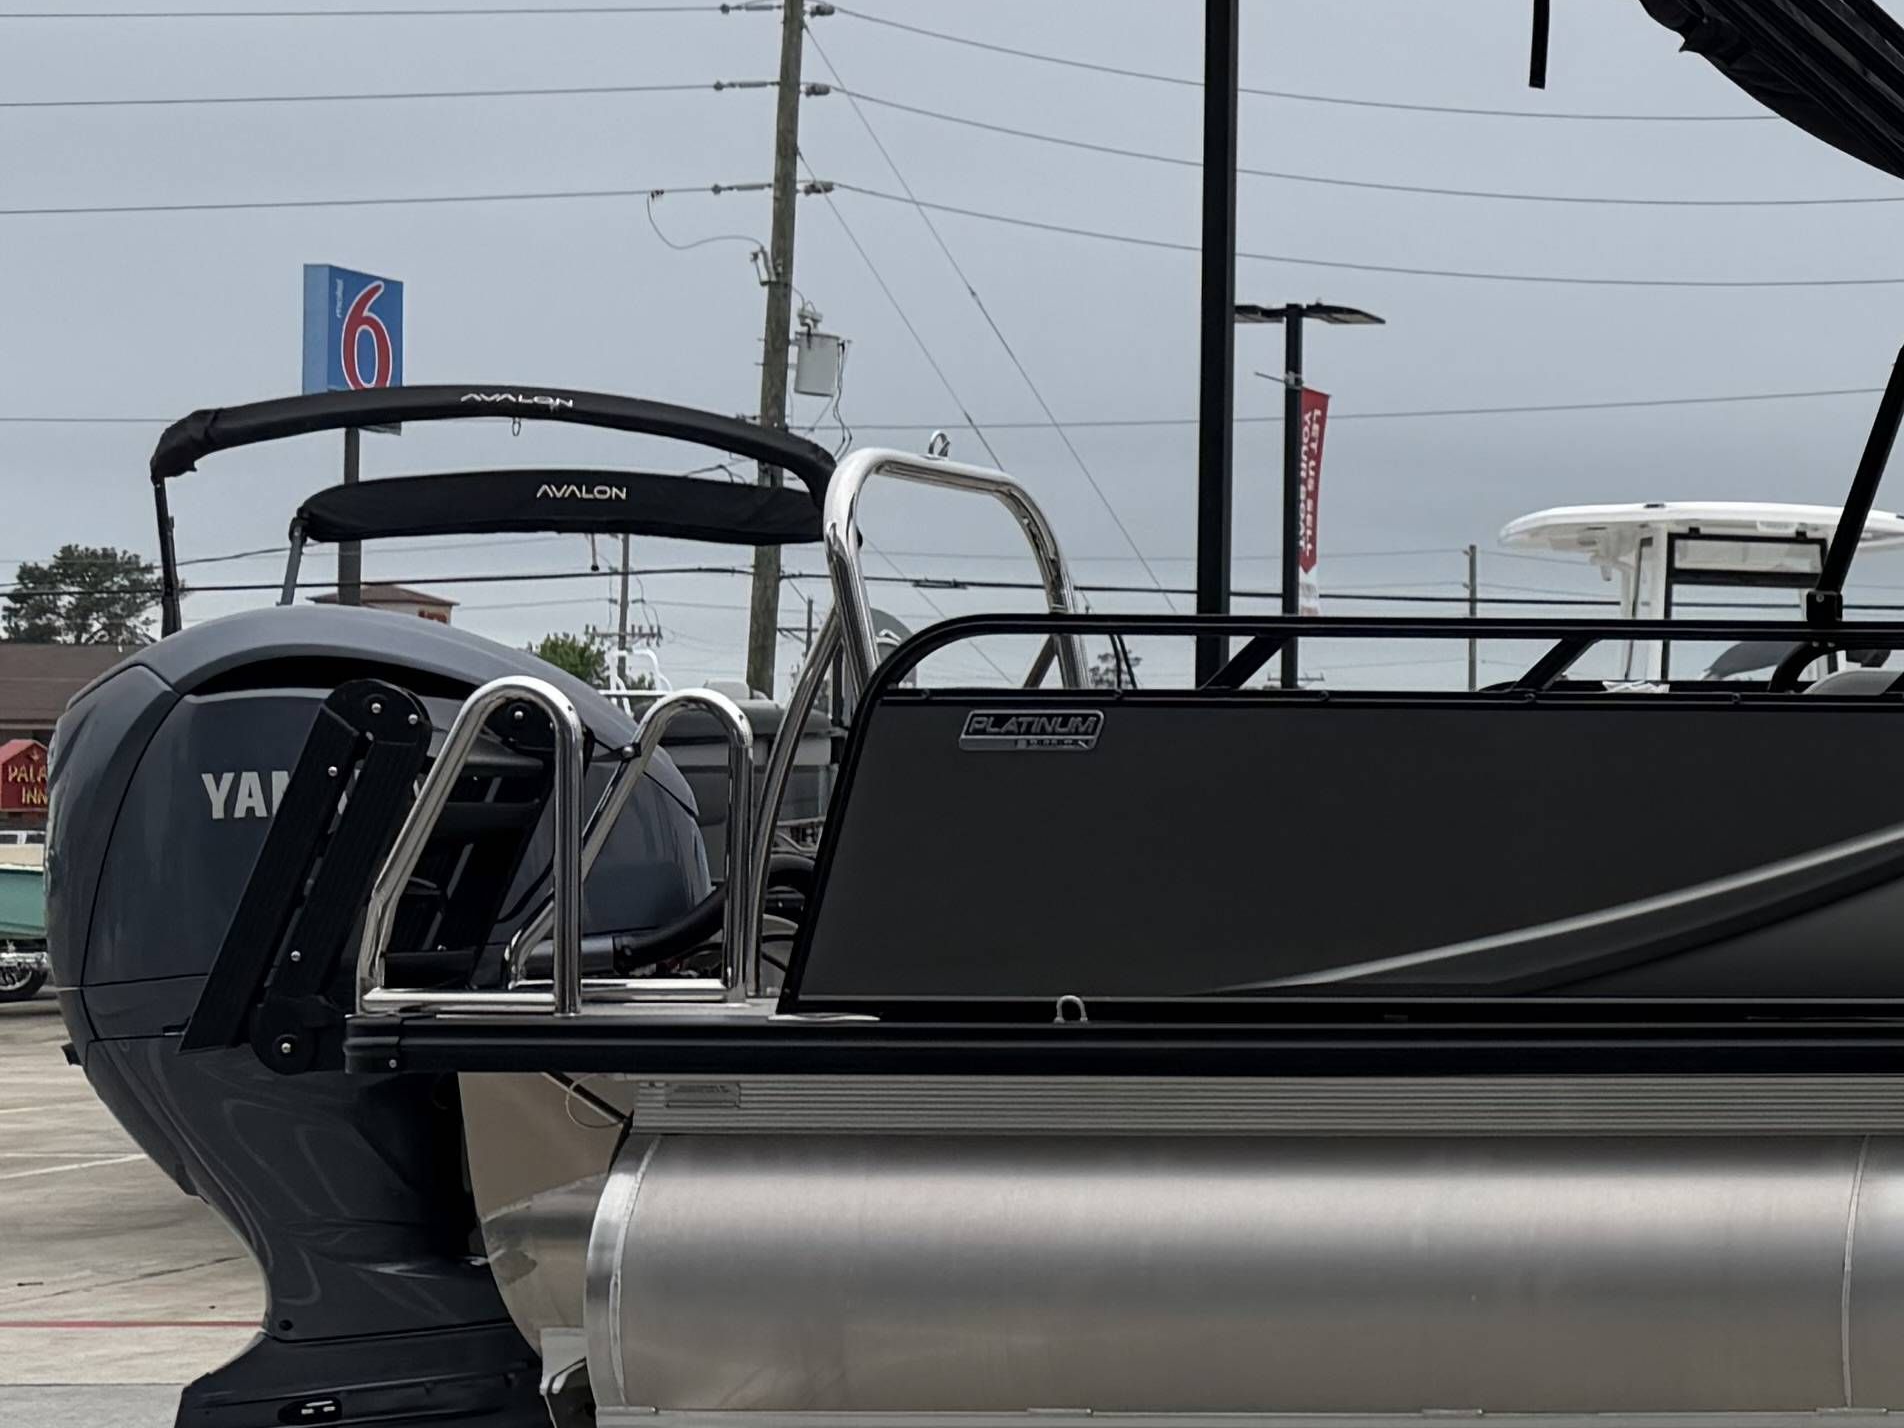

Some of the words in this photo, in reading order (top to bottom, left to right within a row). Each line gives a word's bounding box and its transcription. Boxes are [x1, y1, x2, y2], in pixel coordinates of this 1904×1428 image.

[341, 280, 393, 391] 6
[460, 393, 574, 408] AVALON
[1310, 409, 1321, 455] LET
[536, 484, 627, 500] AVALON
[1308, 459, 1317, 492] US
[1305, 498, 1314, 557] SELL
[968, 716, 1098, 734] PLATINUM
